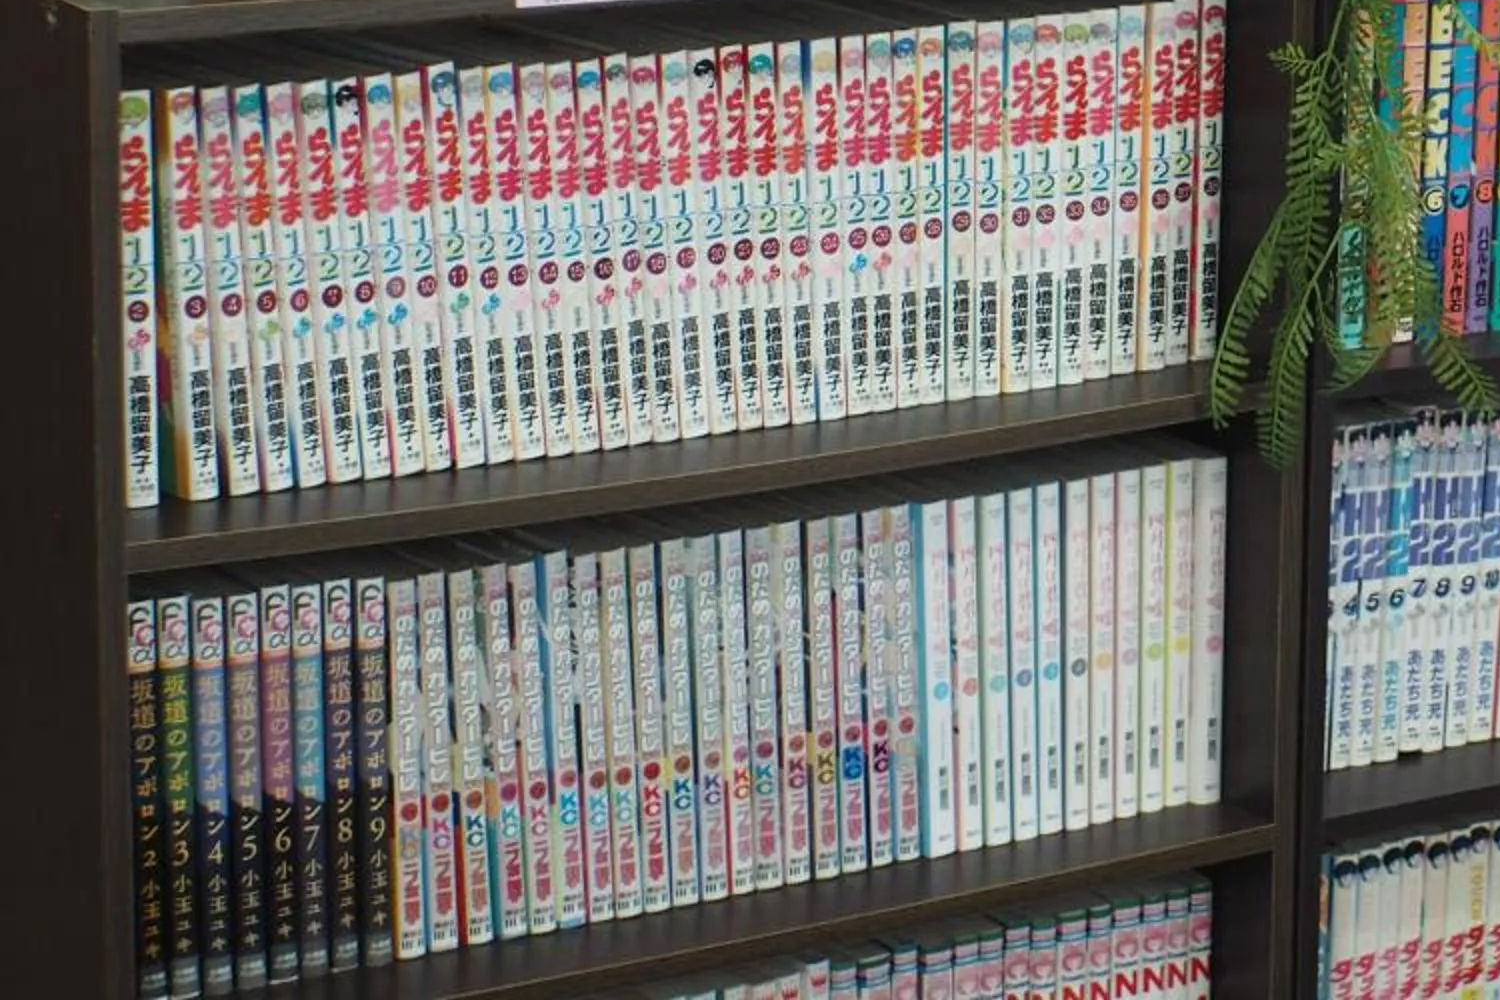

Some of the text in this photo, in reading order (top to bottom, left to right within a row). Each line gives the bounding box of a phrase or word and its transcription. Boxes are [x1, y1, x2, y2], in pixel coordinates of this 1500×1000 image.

[1428, 192, 1444, 211] 6
[1454, 187, 1467, 206] 7
[1481, 182, 1493, 201] 8
[1366, 594, 1379, 612] 5
[1390, 589, 1404, 608] 6
[1411, 579, 1425, 597] 7
[1435, 578, 1450, 597] 8
[1460, 575, 1475, 594] 9
[131, 678, 159, 957] 坂道のアポロン 2 小玉ユキ
[163, 674, 192, 953] 坂道のアポロン 3 小玉ユキ
[199, 675, 228, 950] 坂道のアポロン 4 小玉ユキ
[231, 670, 260, 946] 坂道のアポロン 5 小玉ユキ
[266, 660, 293, 937] 坂道のアポロン 6 小玉ユキ
[296, 660, 323, 935] 坂道のアポロン 7 小玉ユキ
[328, 653, 355, 927] 坂道のアポロン 8 小玉ユキ
[361, 653, 387, 925] 坂道のアポロン 9 小玉ユキ
